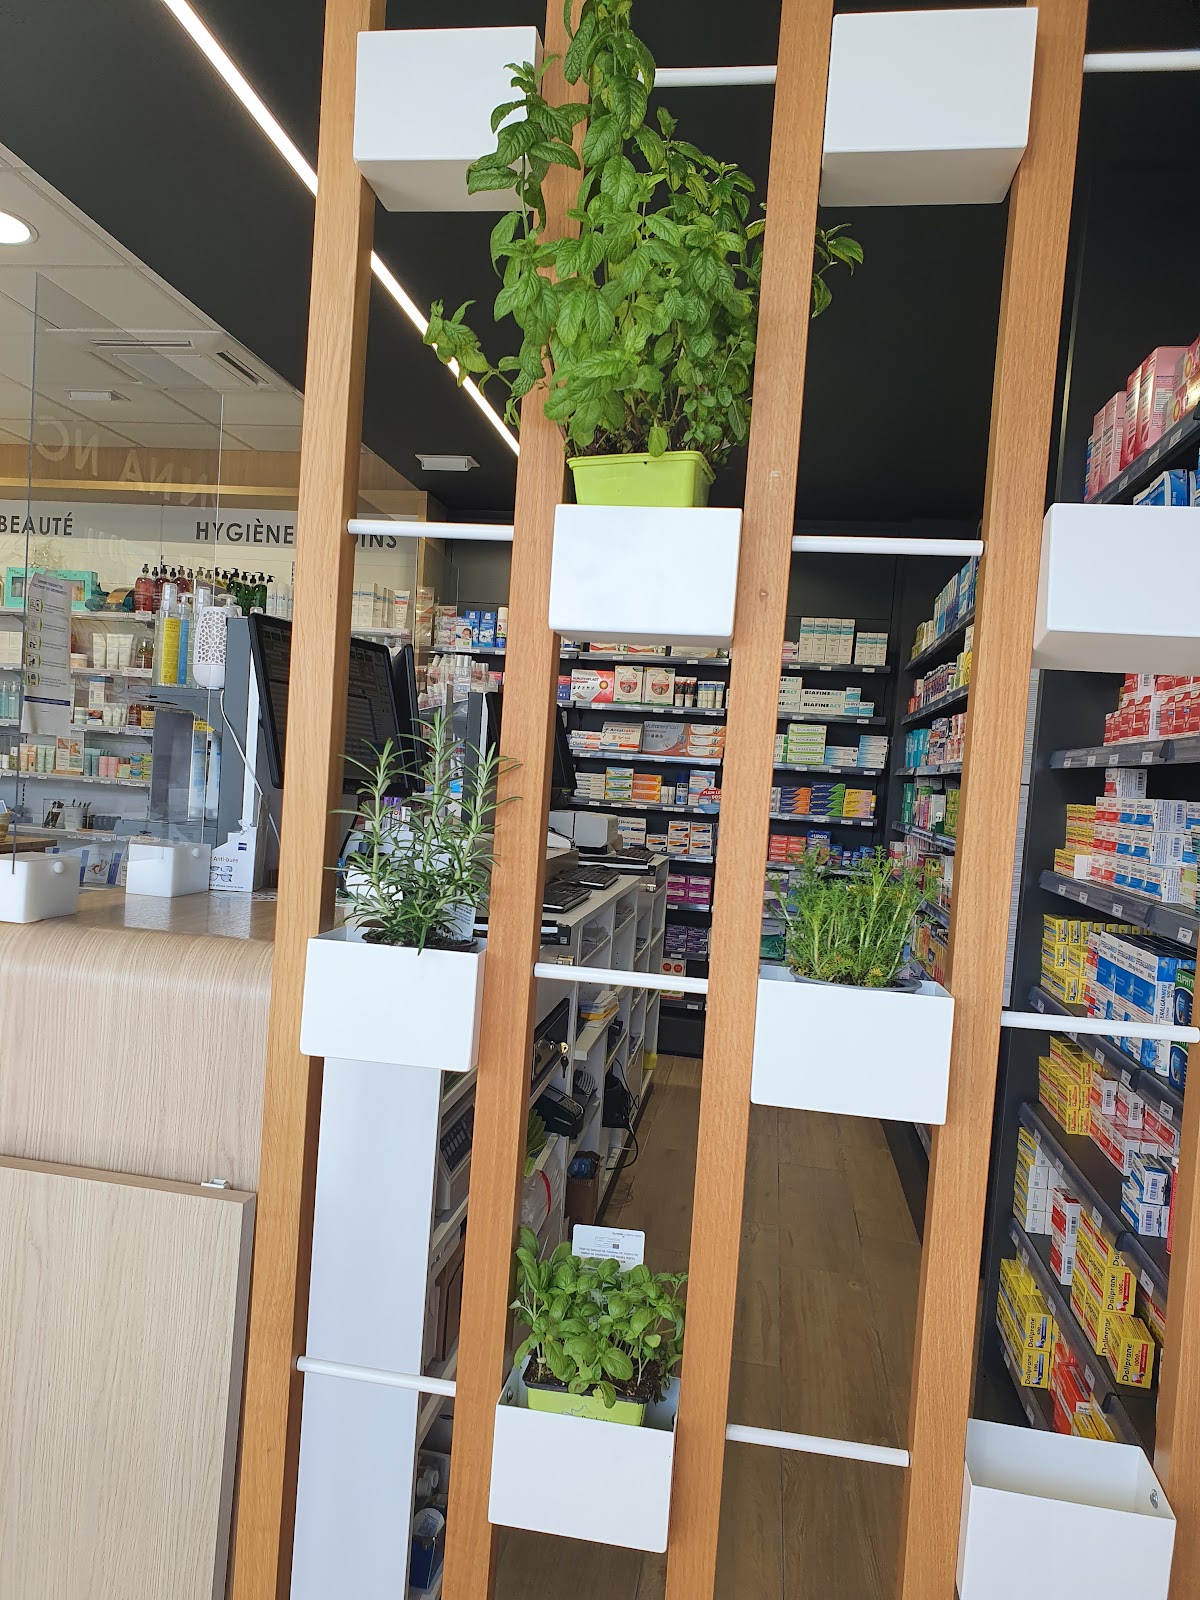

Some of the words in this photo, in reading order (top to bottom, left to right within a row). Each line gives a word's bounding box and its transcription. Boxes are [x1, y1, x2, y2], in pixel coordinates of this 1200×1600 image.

[0, 512, 74, 536] BEAUTÉ
[195, 518, 295, 544] HYGIÈNE
[1107, 1274, 1116, 1311] Doliprane
[1028, 1317, 1036, 1348] Doliprane
[1024, 1354, 1032, 1385] Doliprane
[1122, 1343, 1132, 1382] Doliprane
